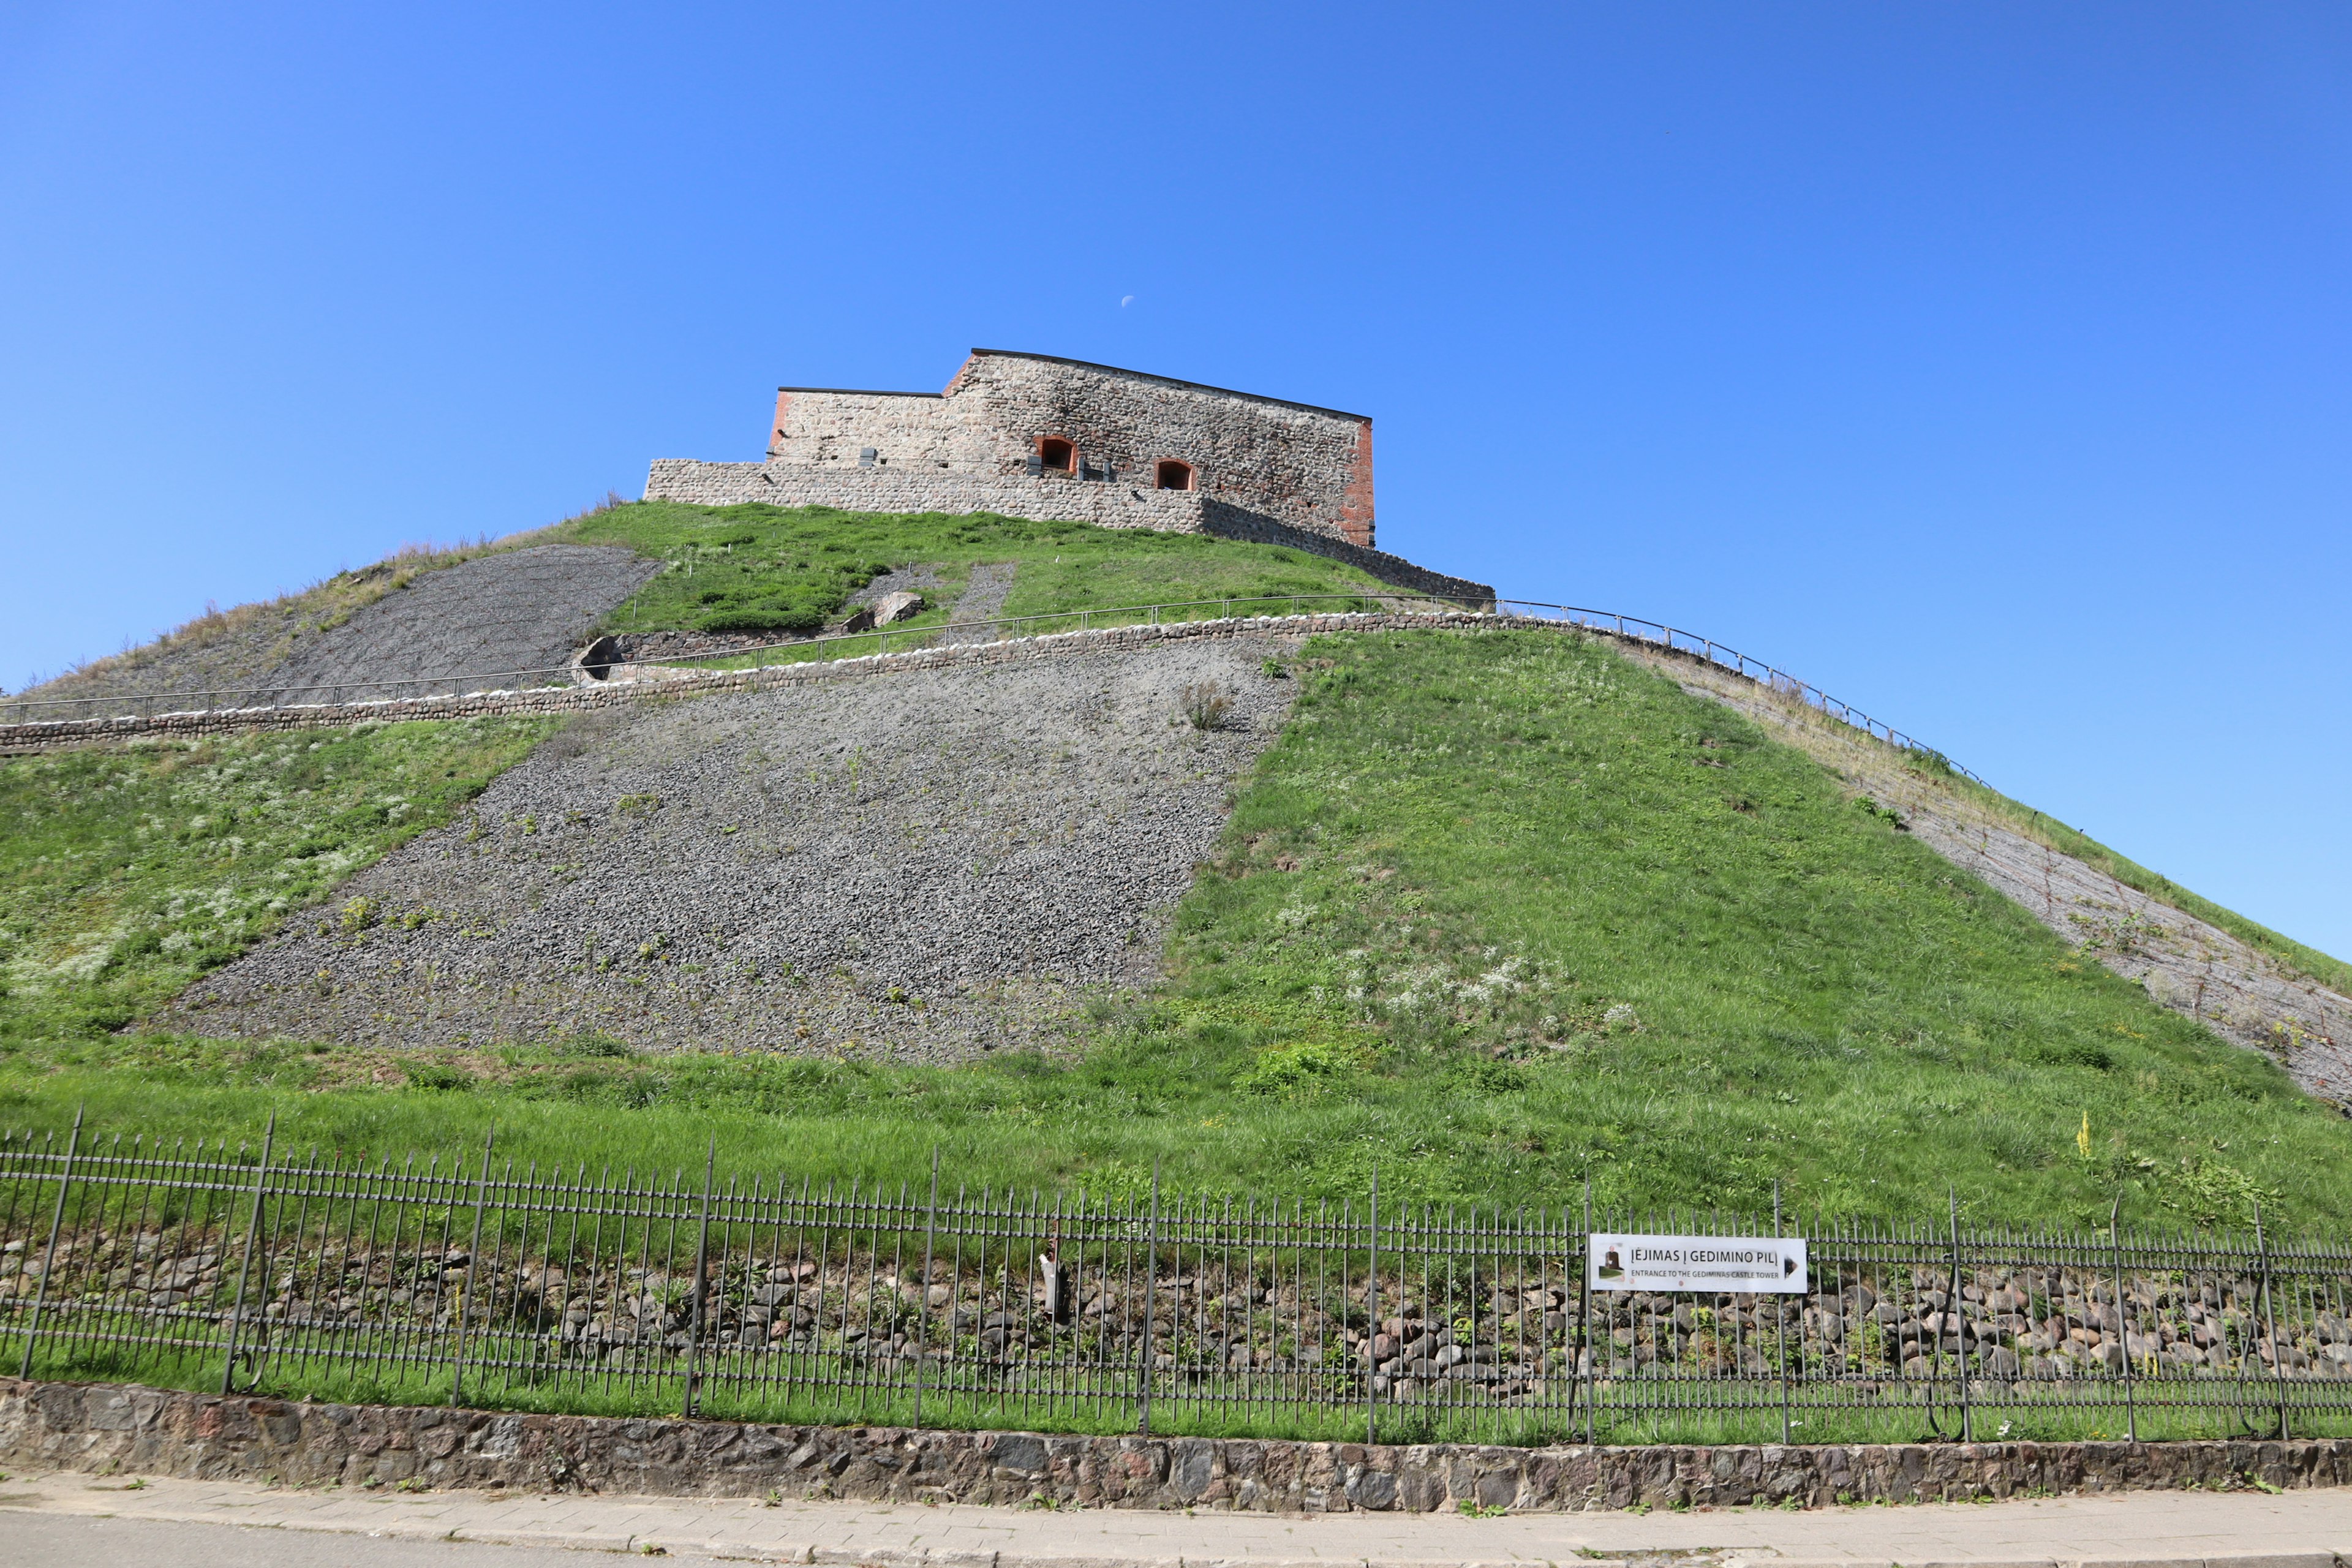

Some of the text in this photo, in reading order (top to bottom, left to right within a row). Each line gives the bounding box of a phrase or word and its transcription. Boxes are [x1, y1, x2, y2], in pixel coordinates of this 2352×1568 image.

[1631, 1247, 1679, 1264] ĮĖJIMAS
[1691, 1251, 1753, 1262] GEDIMINO
[1757, 1252, 1777, 1266] PILĮ
